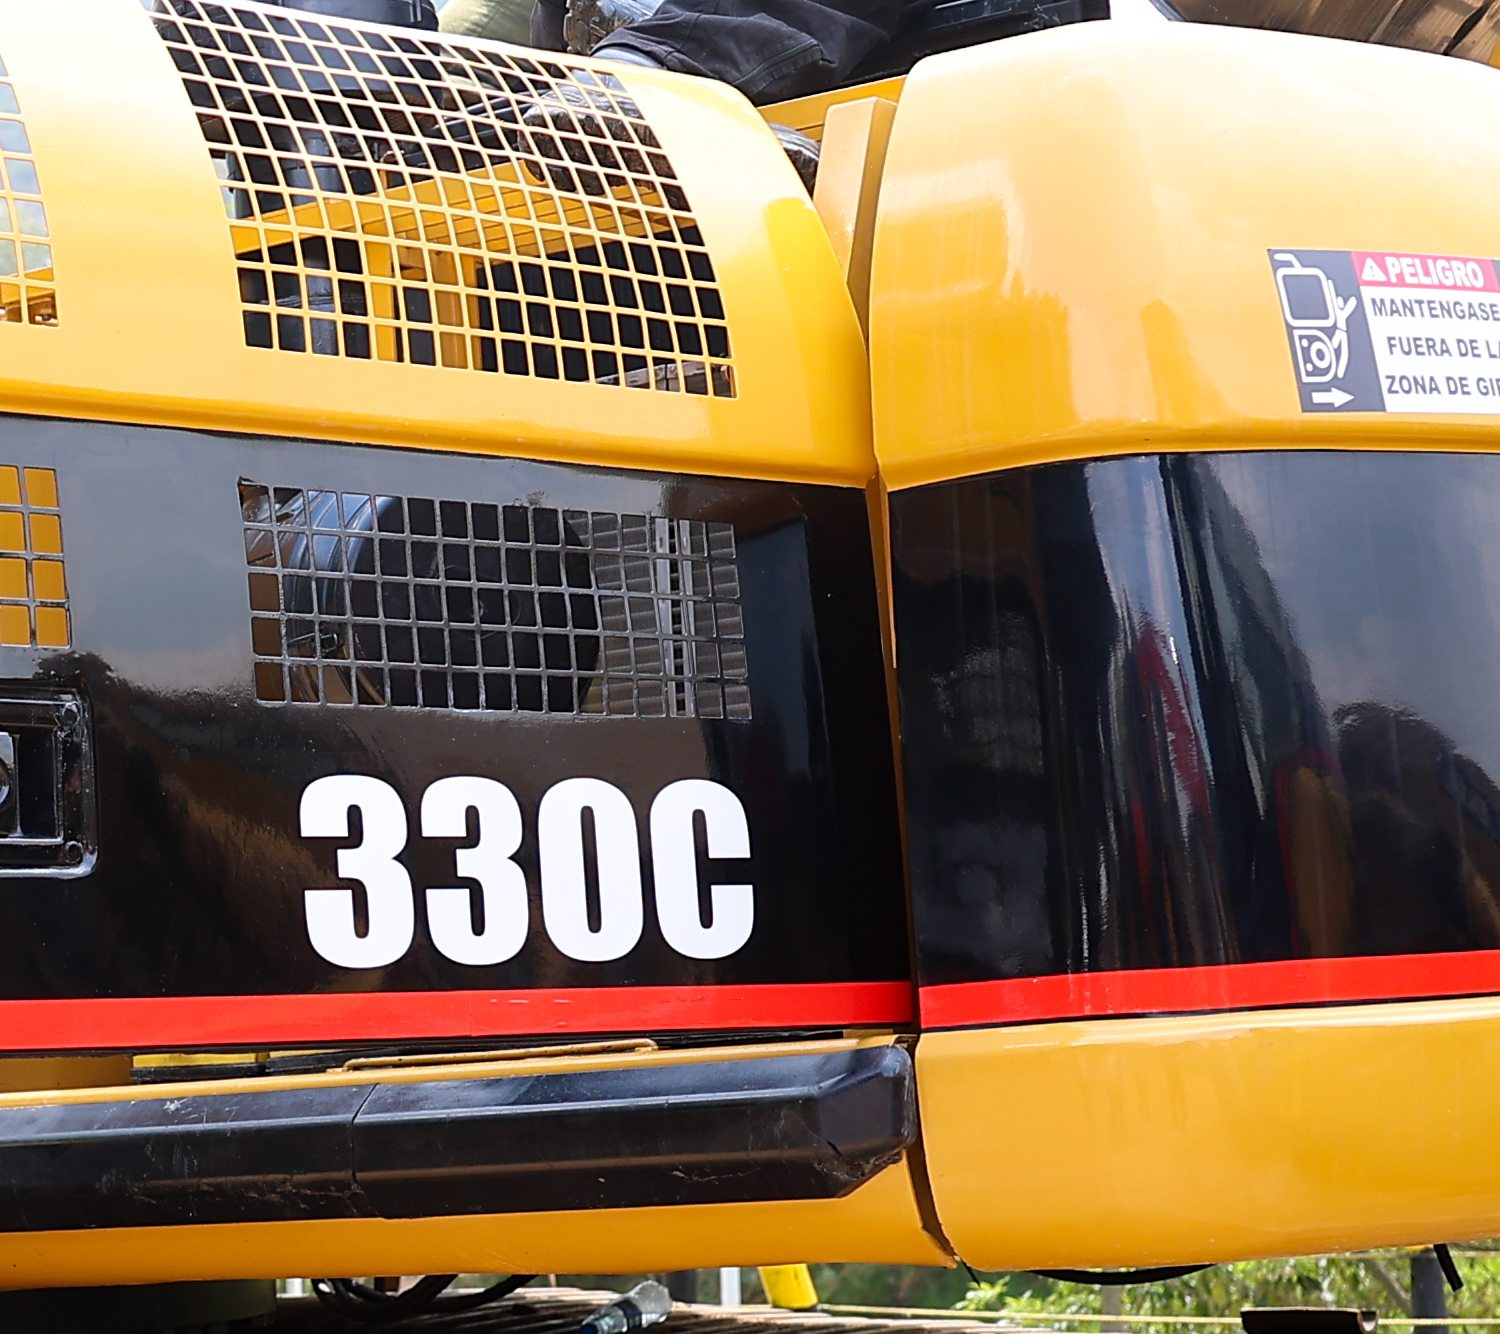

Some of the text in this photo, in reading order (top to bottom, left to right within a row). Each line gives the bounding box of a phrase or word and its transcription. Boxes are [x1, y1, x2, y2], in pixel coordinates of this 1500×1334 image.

[1384, 256, 1485, 288] PELIGRO
[1387, 336, 1452, 358] FUERA
[1456, 338, 1480, 358] DE
[1385, 375, 1441, 395] ZONA
[1446, 376, 1473, 397] DE
[300, 774, 755, 969] 330C
